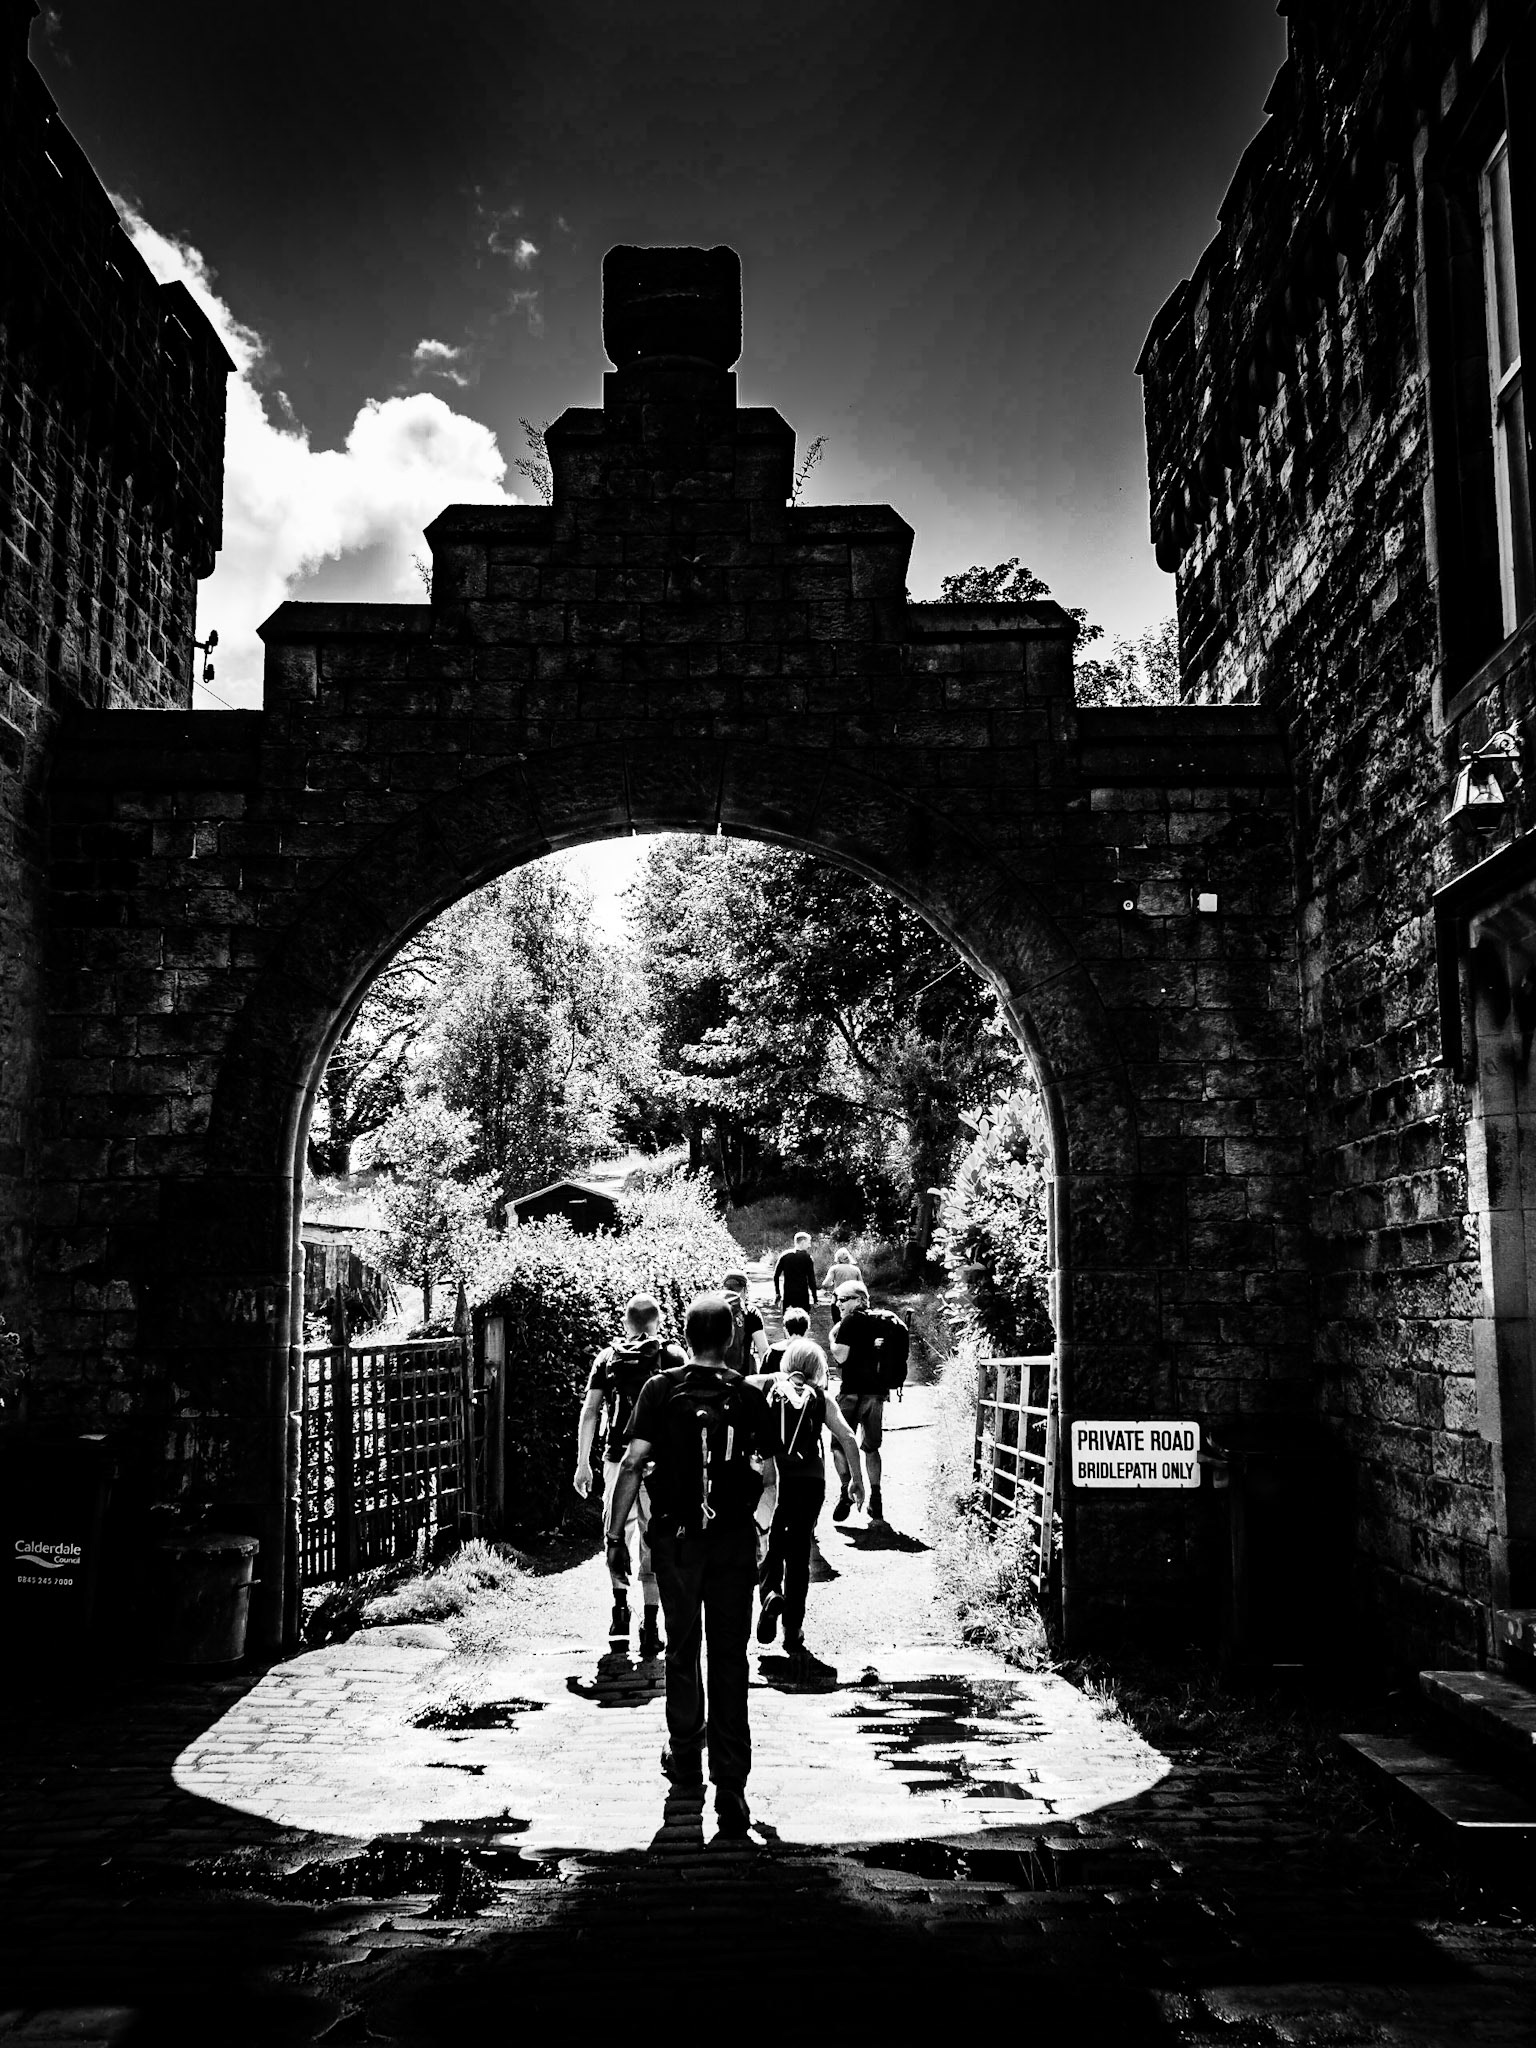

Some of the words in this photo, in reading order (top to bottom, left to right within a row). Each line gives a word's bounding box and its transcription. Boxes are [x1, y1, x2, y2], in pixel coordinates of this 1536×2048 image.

[1077, 1430, 1145, 1451] PRIVATE
[1150, 1430, 1195, 1451] ROAD
[1078, 1462, 1157, 1479] BRIDLEPATH
[1162, 1462, 1194, 1480] ONLY
[15, 1540, 82, 1555] Calderdale
[53, 1555, 81, 1564] Council
[17, 1576, 36, 1584] 0845
[37, 1576, 52, 1585] 245
[54, 1578, 73, 1586] 7000
